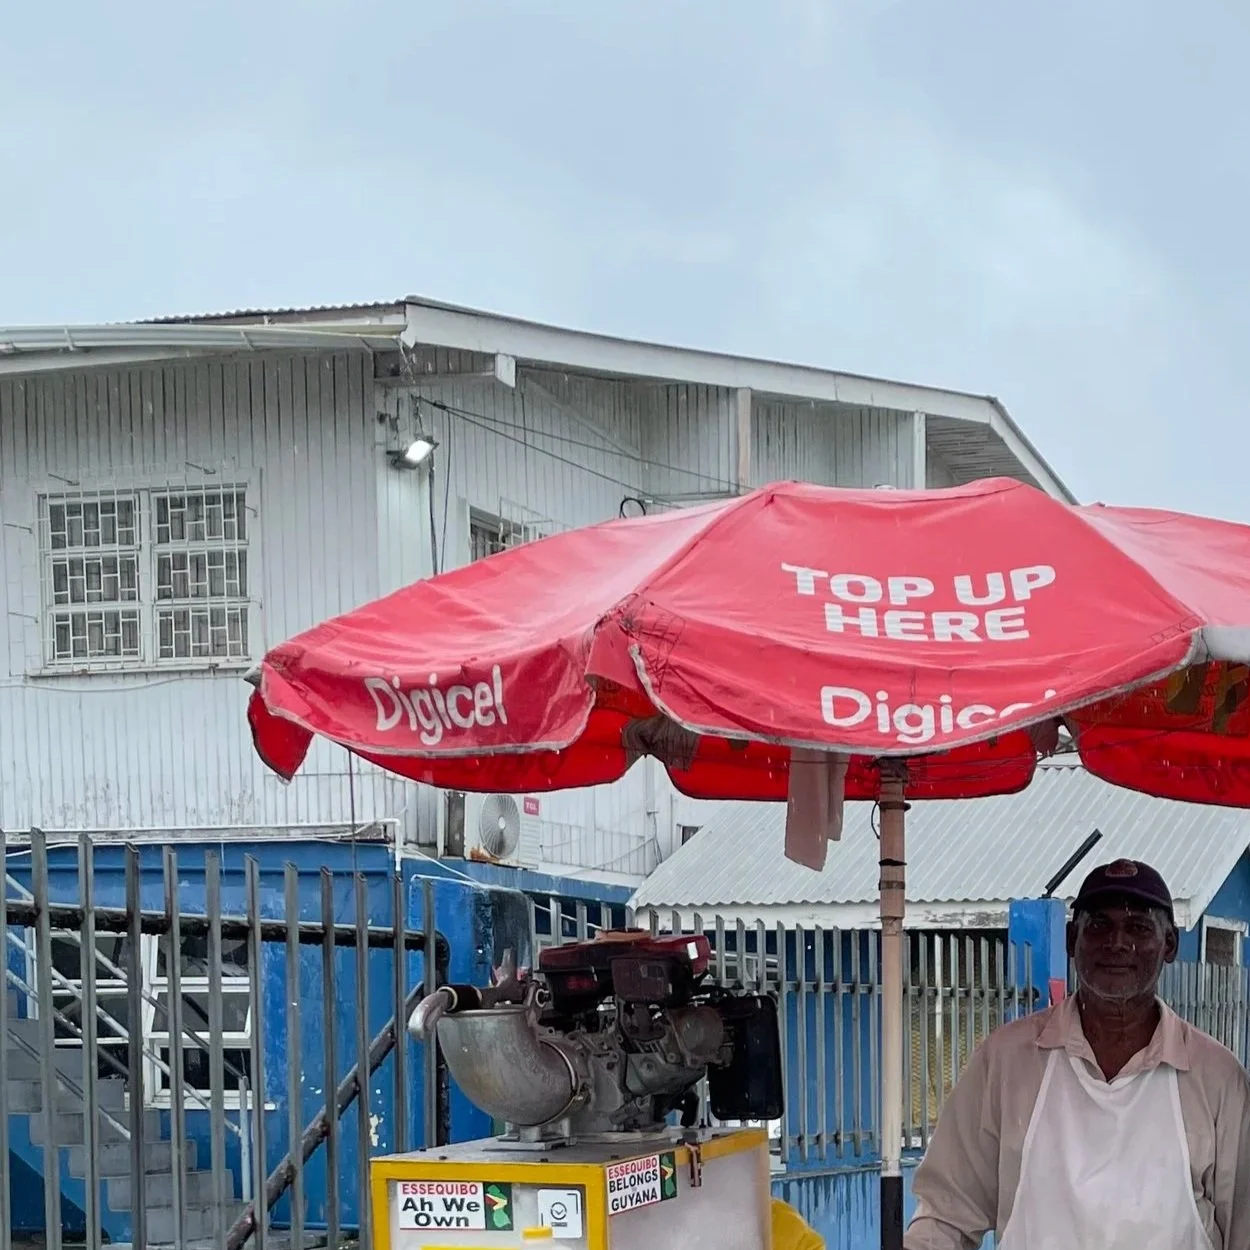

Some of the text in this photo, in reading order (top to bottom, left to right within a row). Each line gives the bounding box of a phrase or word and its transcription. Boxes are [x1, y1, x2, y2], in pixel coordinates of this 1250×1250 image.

[780, 561, 1056, 606] TOP UP
[823, 602, 1030, 642] HERE
[364, 664, 508, 746] Digicel
[820, 686, 1058, 745] Digic
[525, 802, 537, 810] TCL
[608, 1157, 658, 1179] ESSEQUIBO
[609, 1168, 658, 1193] BELONGS
[402, 1184, 478, 1195] ESSEQUIBO
[611, 1187, 658, 1212] GUYANA
[402, 1198, 480, 1212] Ah We
[414, 1212, 470, 1227] Own
